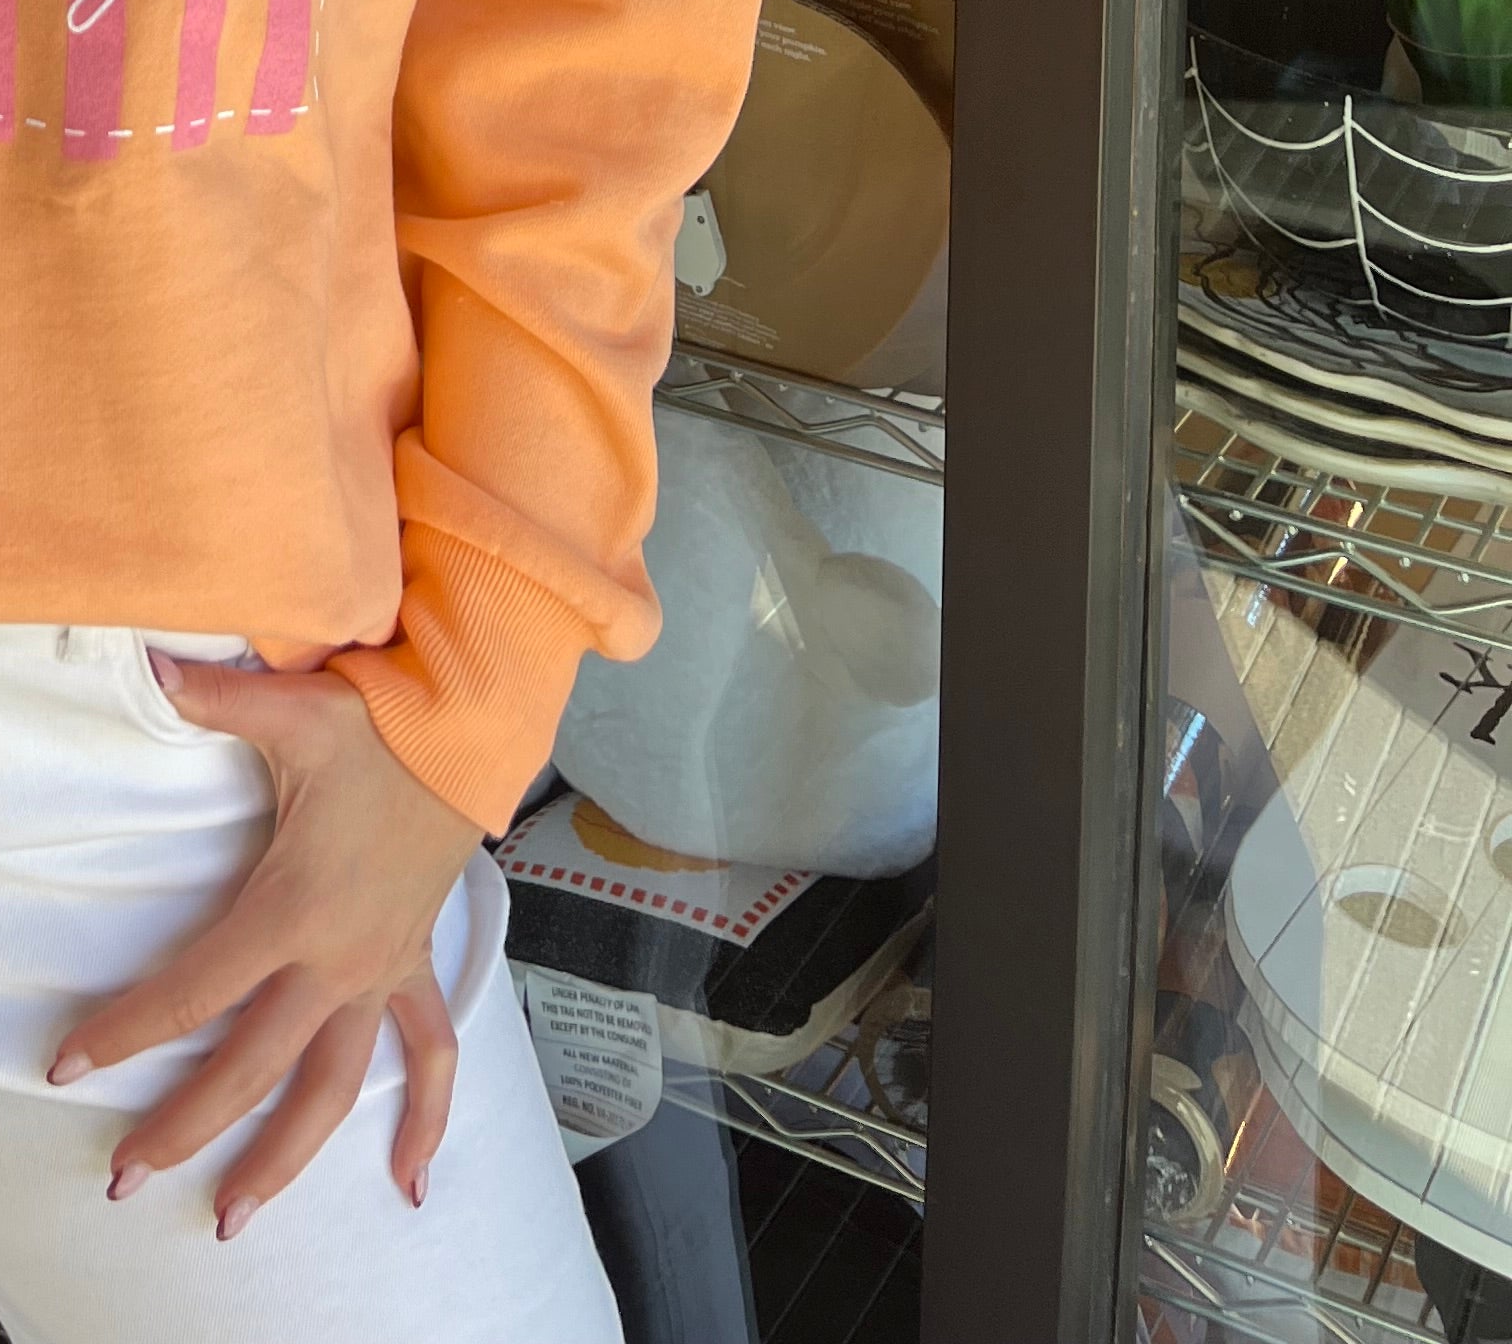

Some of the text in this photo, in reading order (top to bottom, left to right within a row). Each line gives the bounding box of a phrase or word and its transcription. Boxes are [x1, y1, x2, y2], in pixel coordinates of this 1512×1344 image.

[552, 986, 578, 1001] UNDER
[580, 992, 612, 1008] PENALTY
[614, 999, 625, 1010] OF
[542, 1001, 558, 1014] THIS
[560, 1005, 575, 1017] TAG
[577, 1008, 593, 1020] NOT
[594, 1011, 605, 1023] TO
[606, 1014, 615, 1026] BE
[551, 1020, 647, 1051] EXCEPT BY THE CONSUMER
[563, 1048, 577, 1059] ALL
[579, 1051, 600, 1063] NEW
[584, 1079, 624, 1102] POLYESTER
